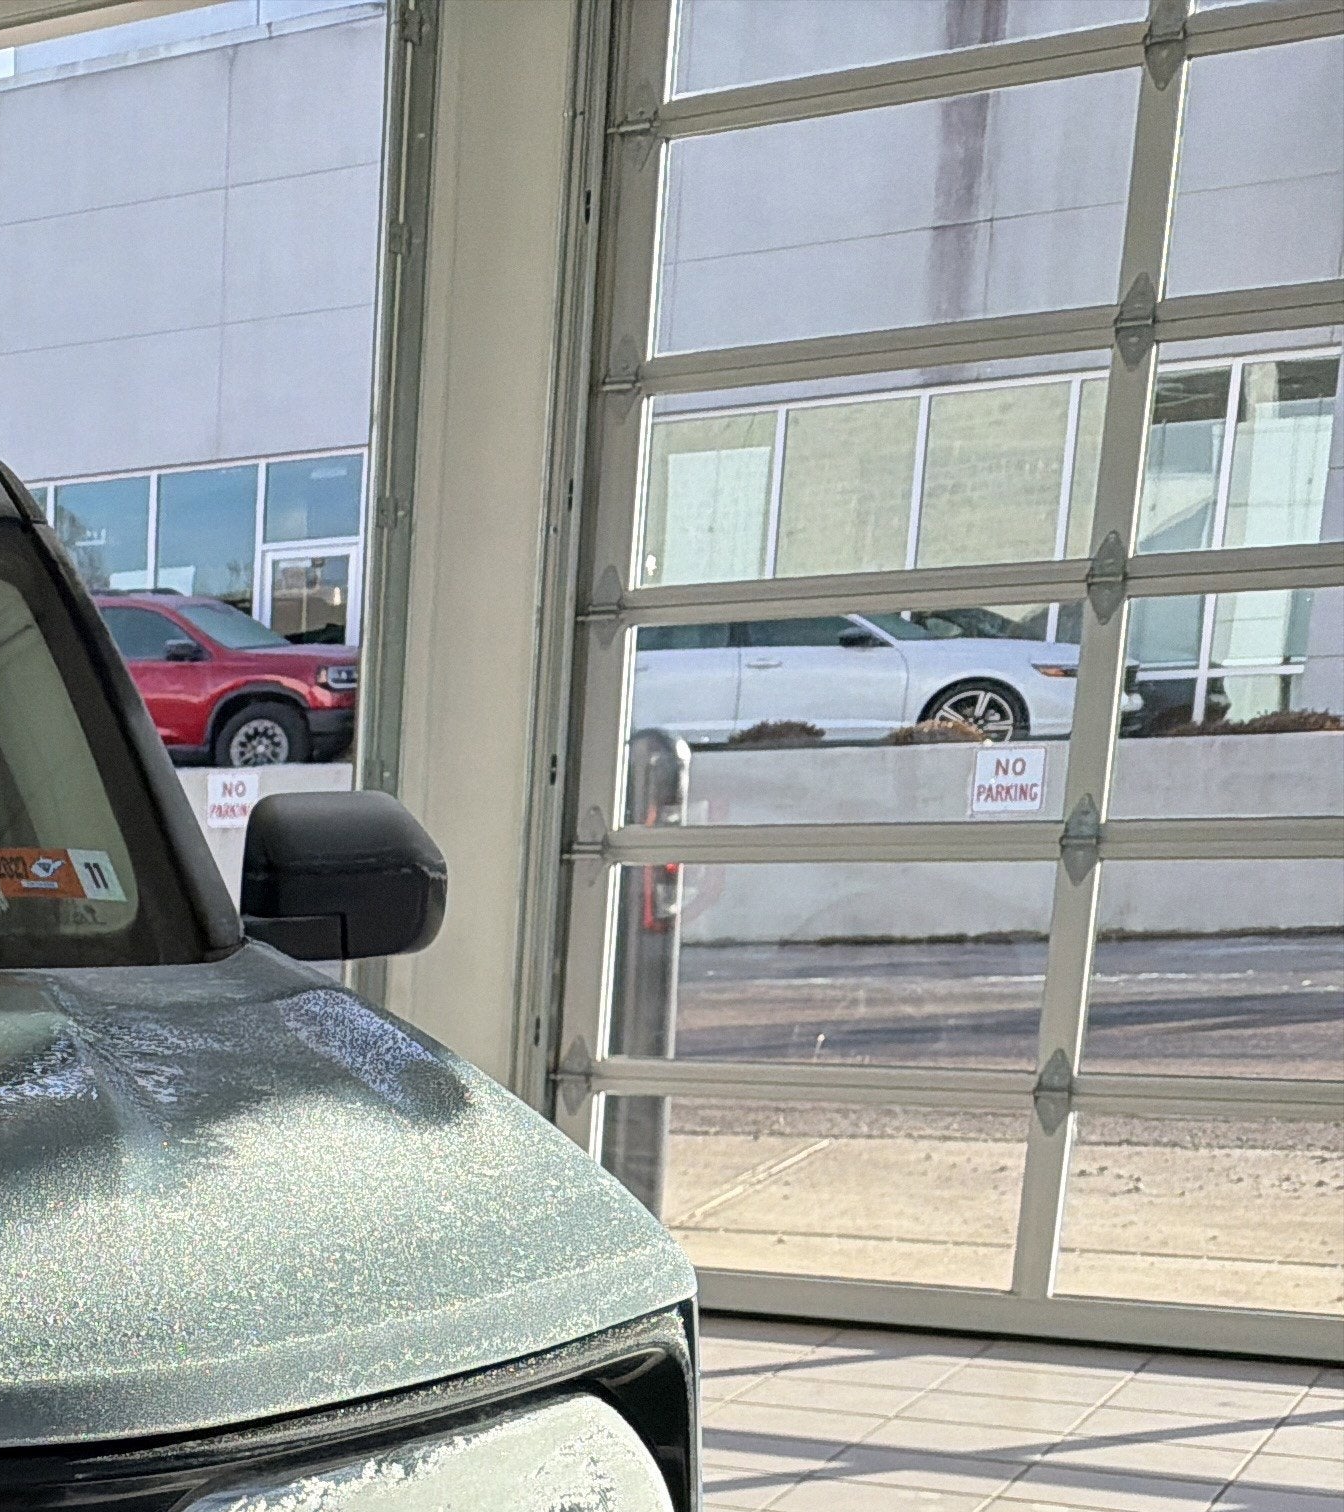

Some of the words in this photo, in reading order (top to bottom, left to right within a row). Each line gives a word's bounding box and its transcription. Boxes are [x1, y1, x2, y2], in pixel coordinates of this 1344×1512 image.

[994, 757, 1026, 776] NO
[222, 781, 247, 798] NO
[976, 783, 1039, 802] PARKING
[83, 862, 109, 889] 11
